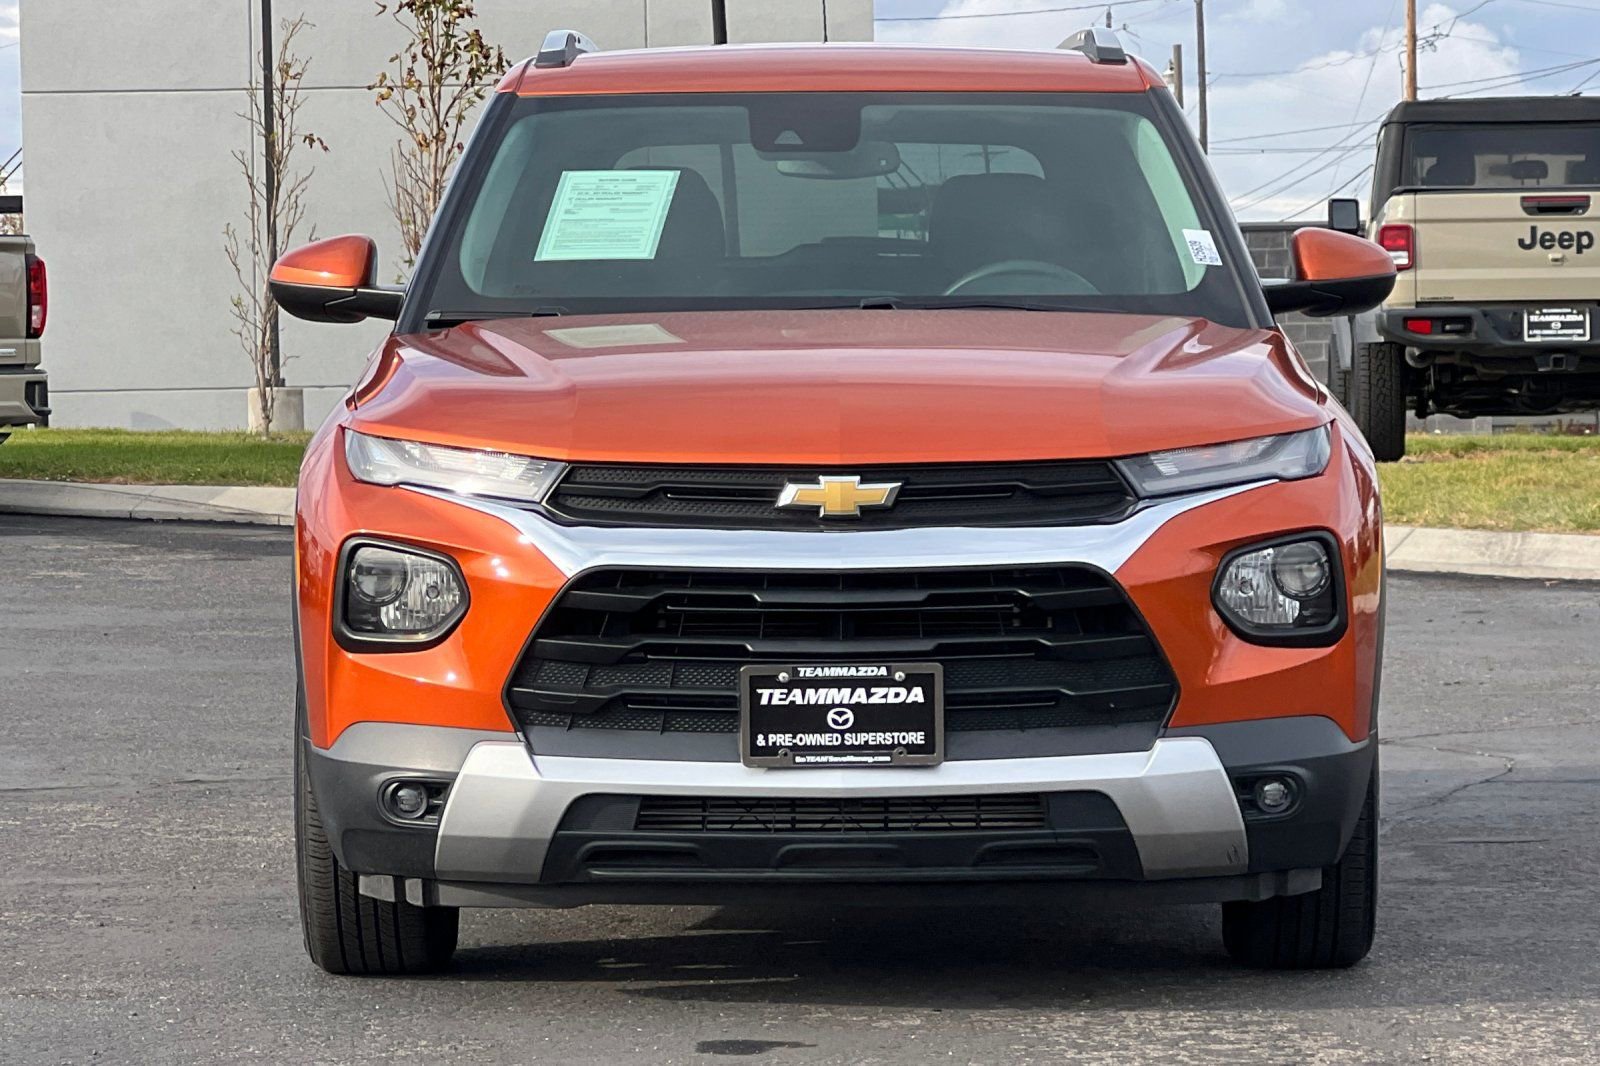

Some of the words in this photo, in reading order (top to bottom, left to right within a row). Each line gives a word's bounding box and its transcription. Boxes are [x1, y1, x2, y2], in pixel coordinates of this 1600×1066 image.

[1517, 225, 1594, 254] Jeep
[797, 666, 888, 678] TEAMMAZDA
[756, 686, 925, 706] TEAMMAZDA
[756, 733, 767, 747] &
[768, 732, 842, 746] PRE-OWNED
[844, 731, 925, 745] SUPERSTORE
